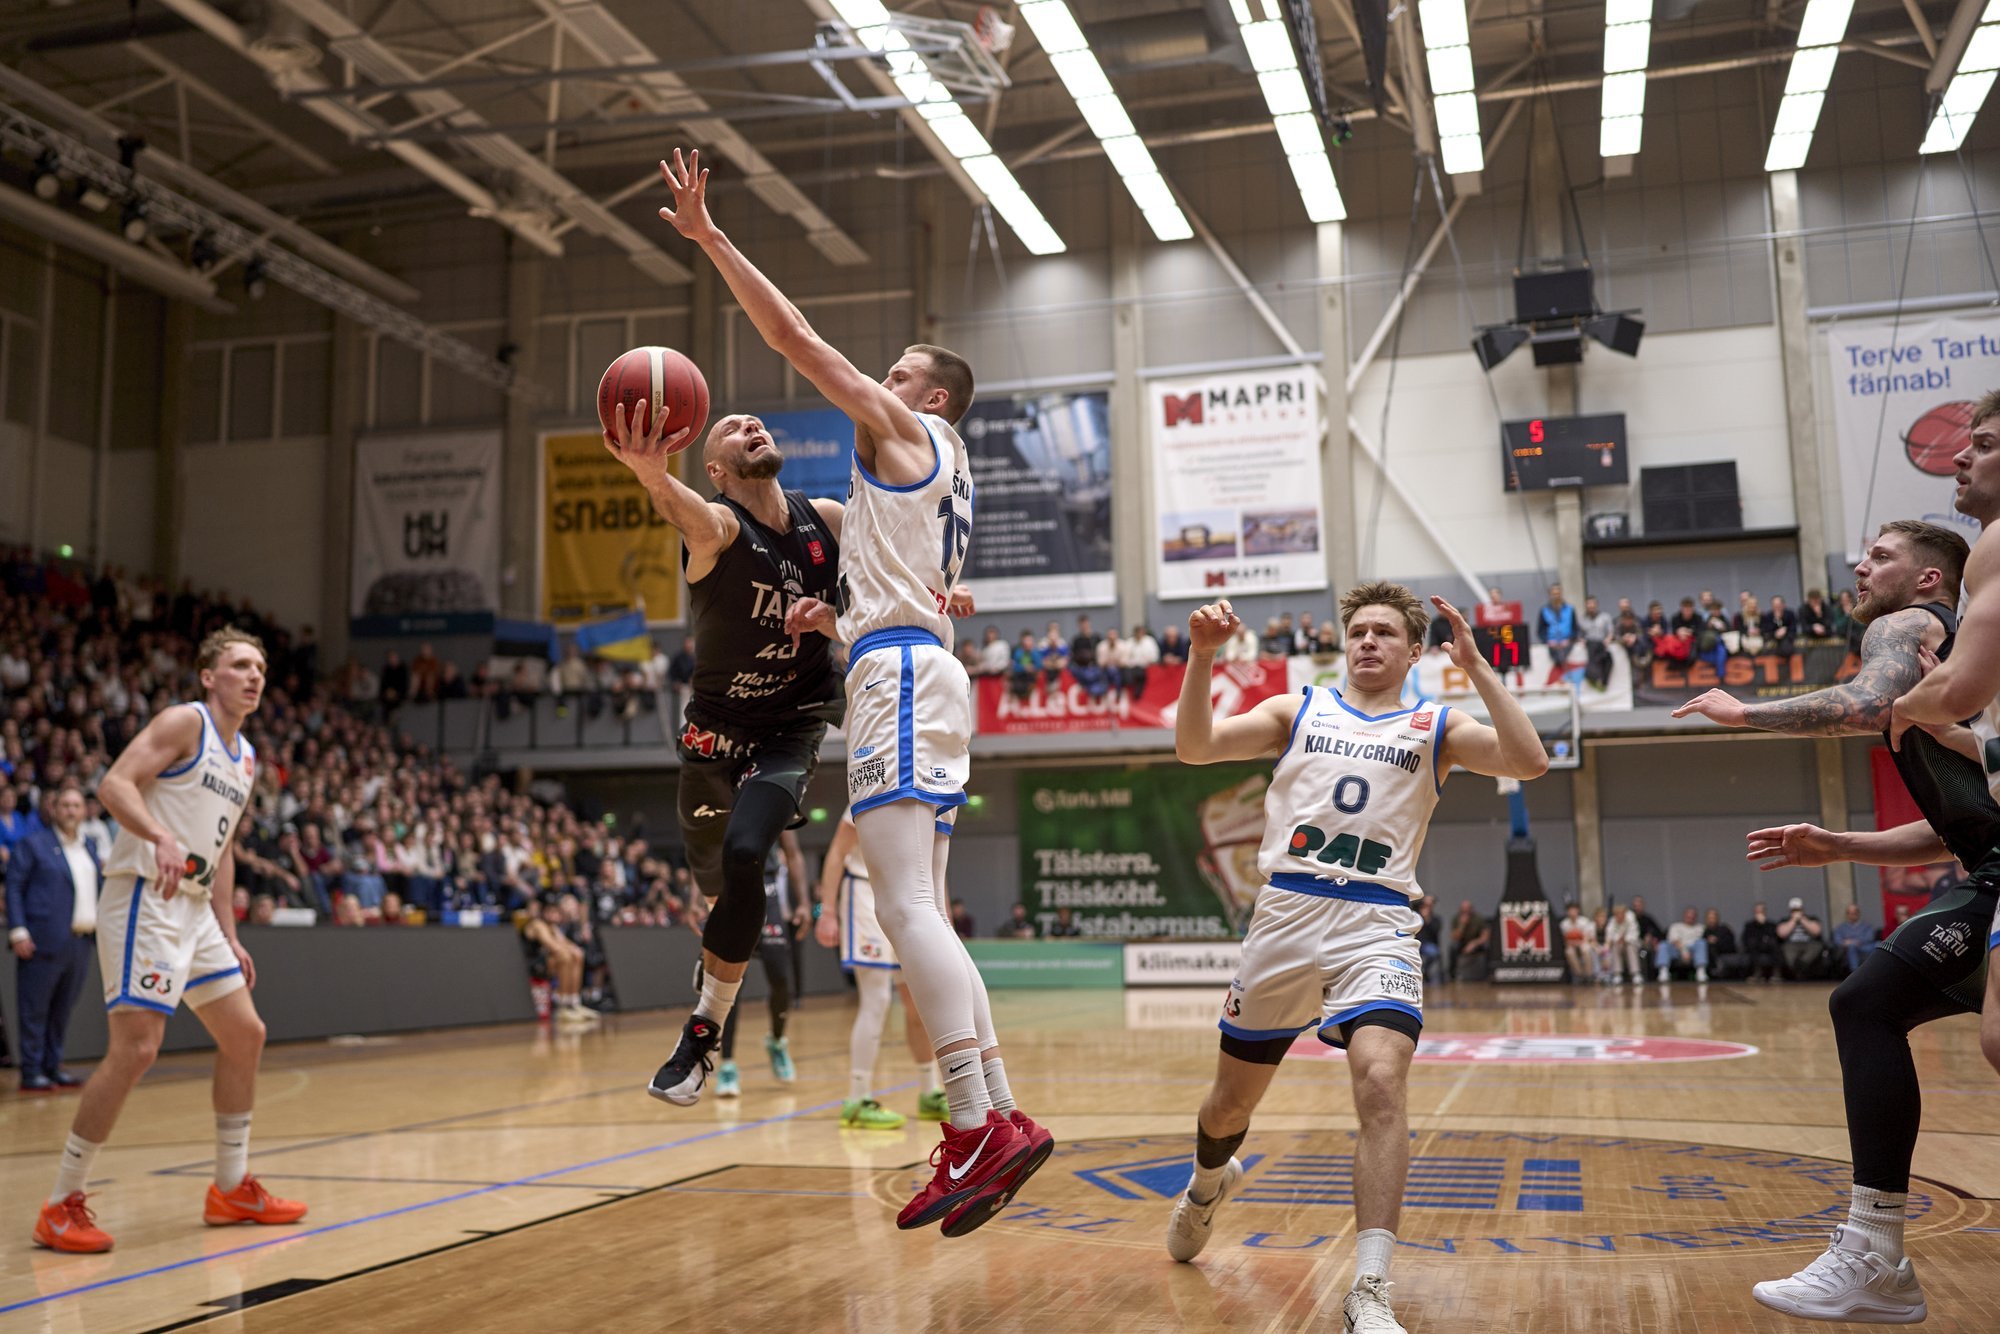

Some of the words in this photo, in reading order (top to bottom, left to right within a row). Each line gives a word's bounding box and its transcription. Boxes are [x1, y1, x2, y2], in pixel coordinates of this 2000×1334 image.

[1846, 344, 1922, 369] Terve
[1932, 334, 2000, 362] Tartu
[1208, 380, 1305, 409] MAPRI
[1848, 366, 1951, 397] fännab!
[1493, 641, 1519, 667] 17
[1304, 734, 1421, 775] KALEV/CRAMO
[1332, 774, 1371, 815] 0
[214, 815, 230, 848] 9
[1034, 847, 1162, 876] Täistera.
[1288, 824, 1393, 876] PAF
[1929, 923, 1969, 958] TARTU
